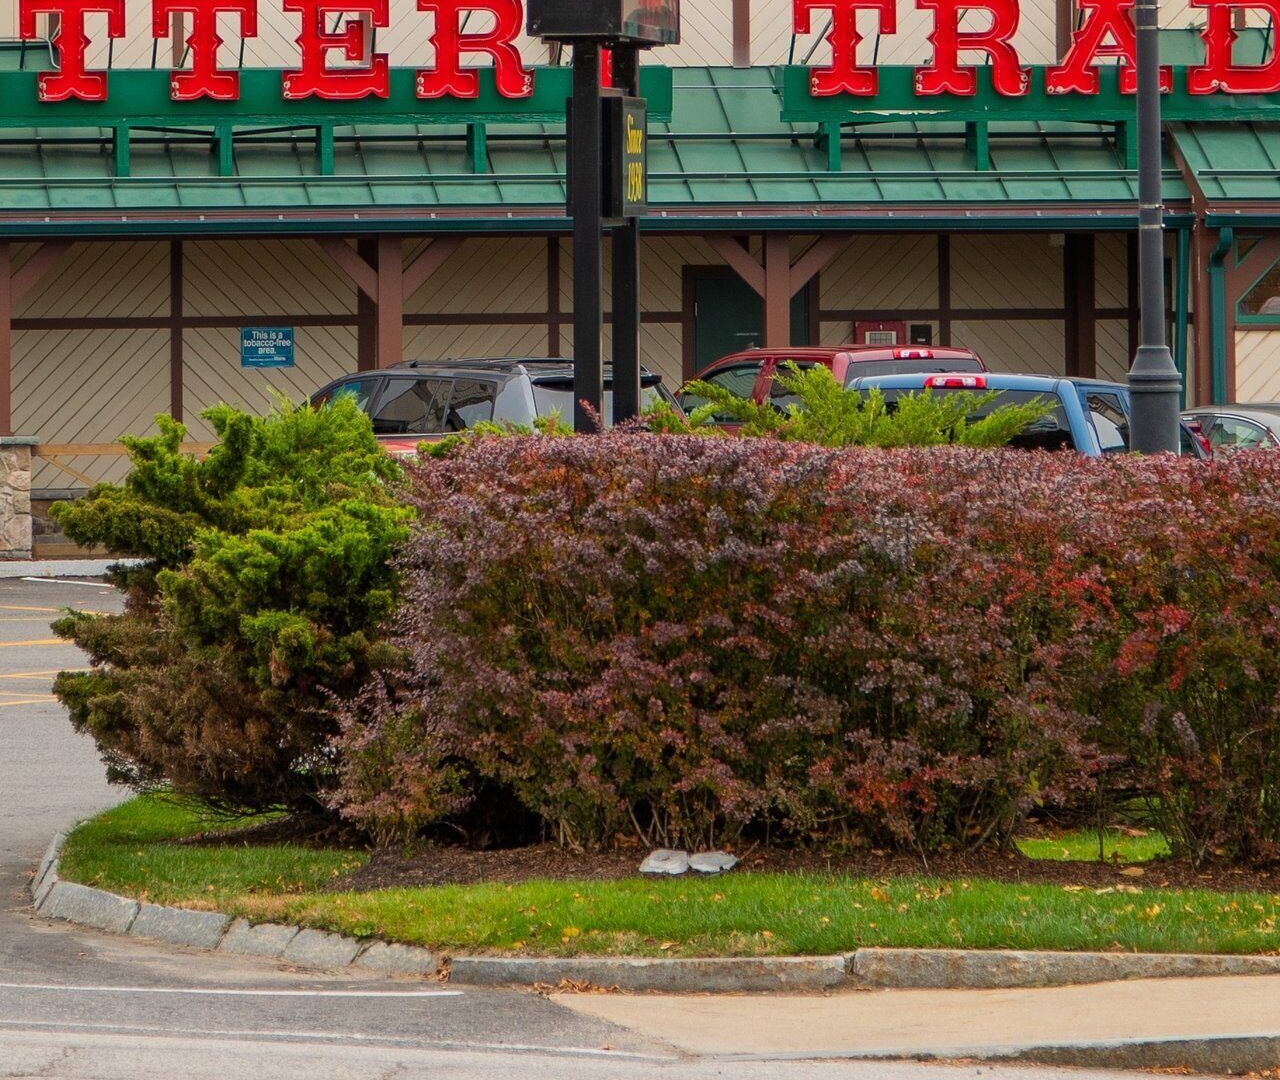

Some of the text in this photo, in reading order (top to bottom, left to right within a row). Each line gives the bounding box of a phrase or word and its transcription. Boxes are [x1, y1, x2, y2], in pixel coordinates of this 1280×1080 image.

[626, 113, 643, 154] Since
[626, 161, 643, 203] 1938
[251, 330, 283, 340] This is a
[243, 339, 292, 347] tobacco-free
[257, 347, 277, 355] area.
